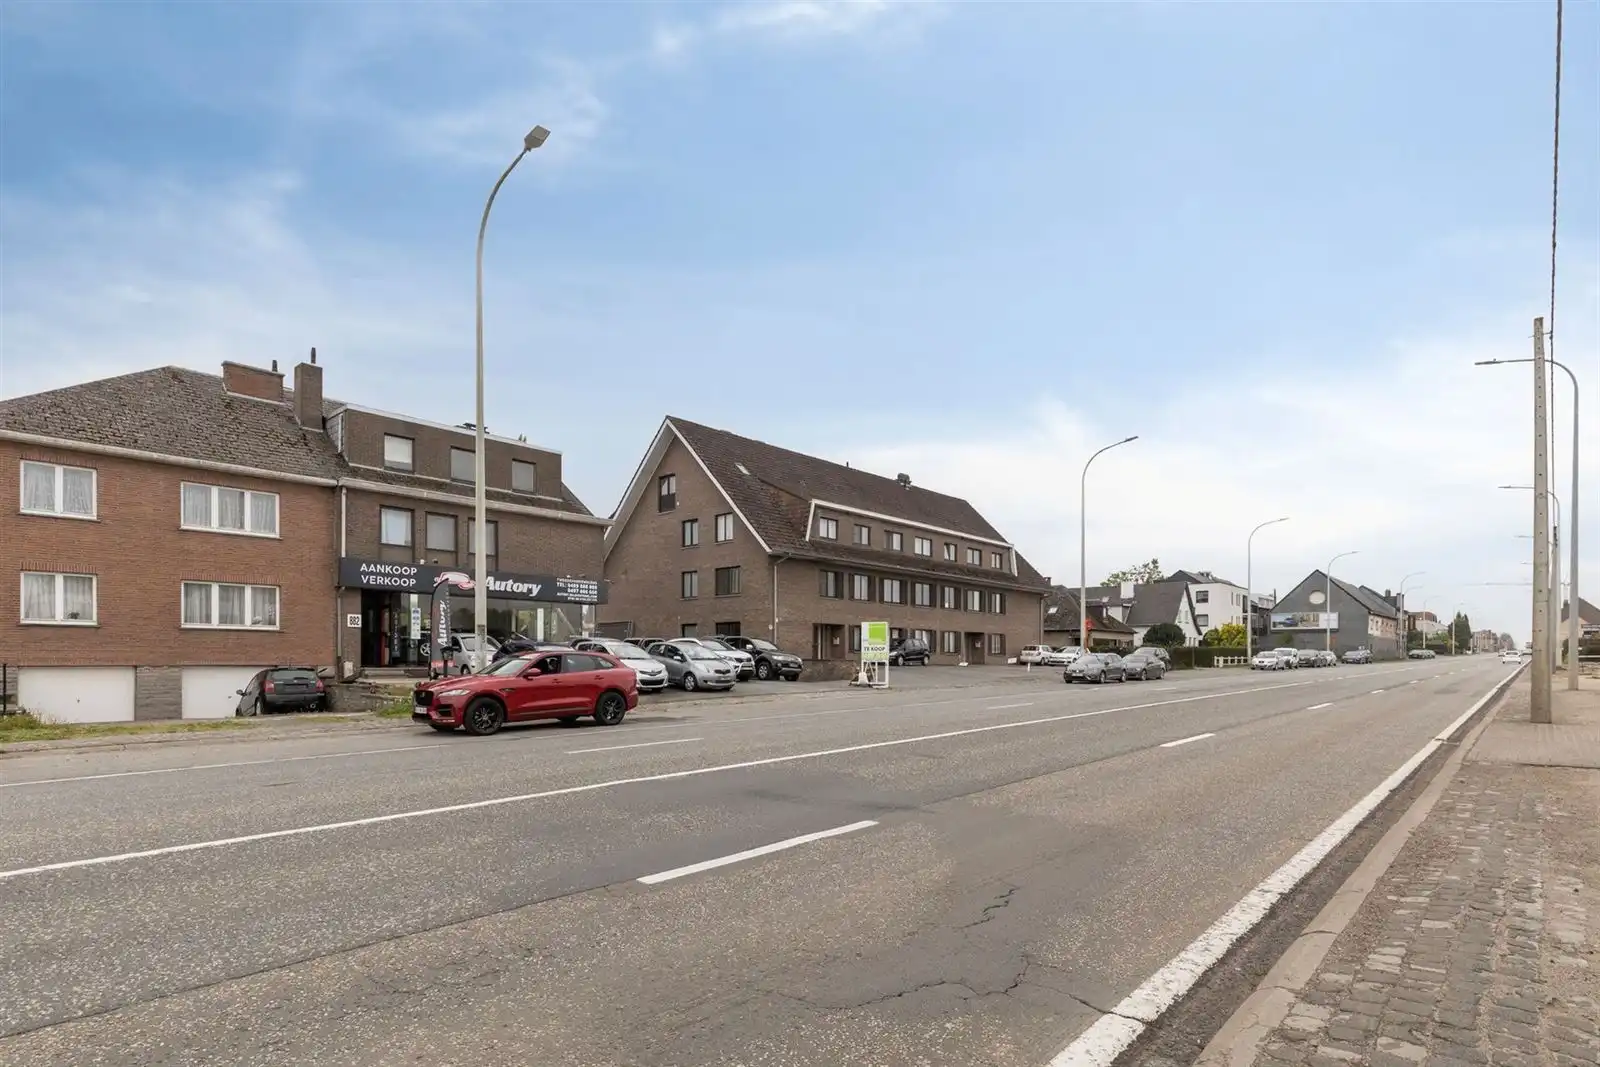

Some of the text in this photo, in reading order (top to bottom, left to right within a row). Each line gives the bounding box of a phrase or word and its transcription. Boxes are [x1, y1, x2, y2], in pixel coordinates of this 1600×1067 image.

[360, 563, 417, 576] AANKOOP
[361, 575, 416, 587] VERKOOP
[486, 576, 541, 597] Autory
[349, 615, 360, 625] 882
[437, 600, 449, 647] Autory
